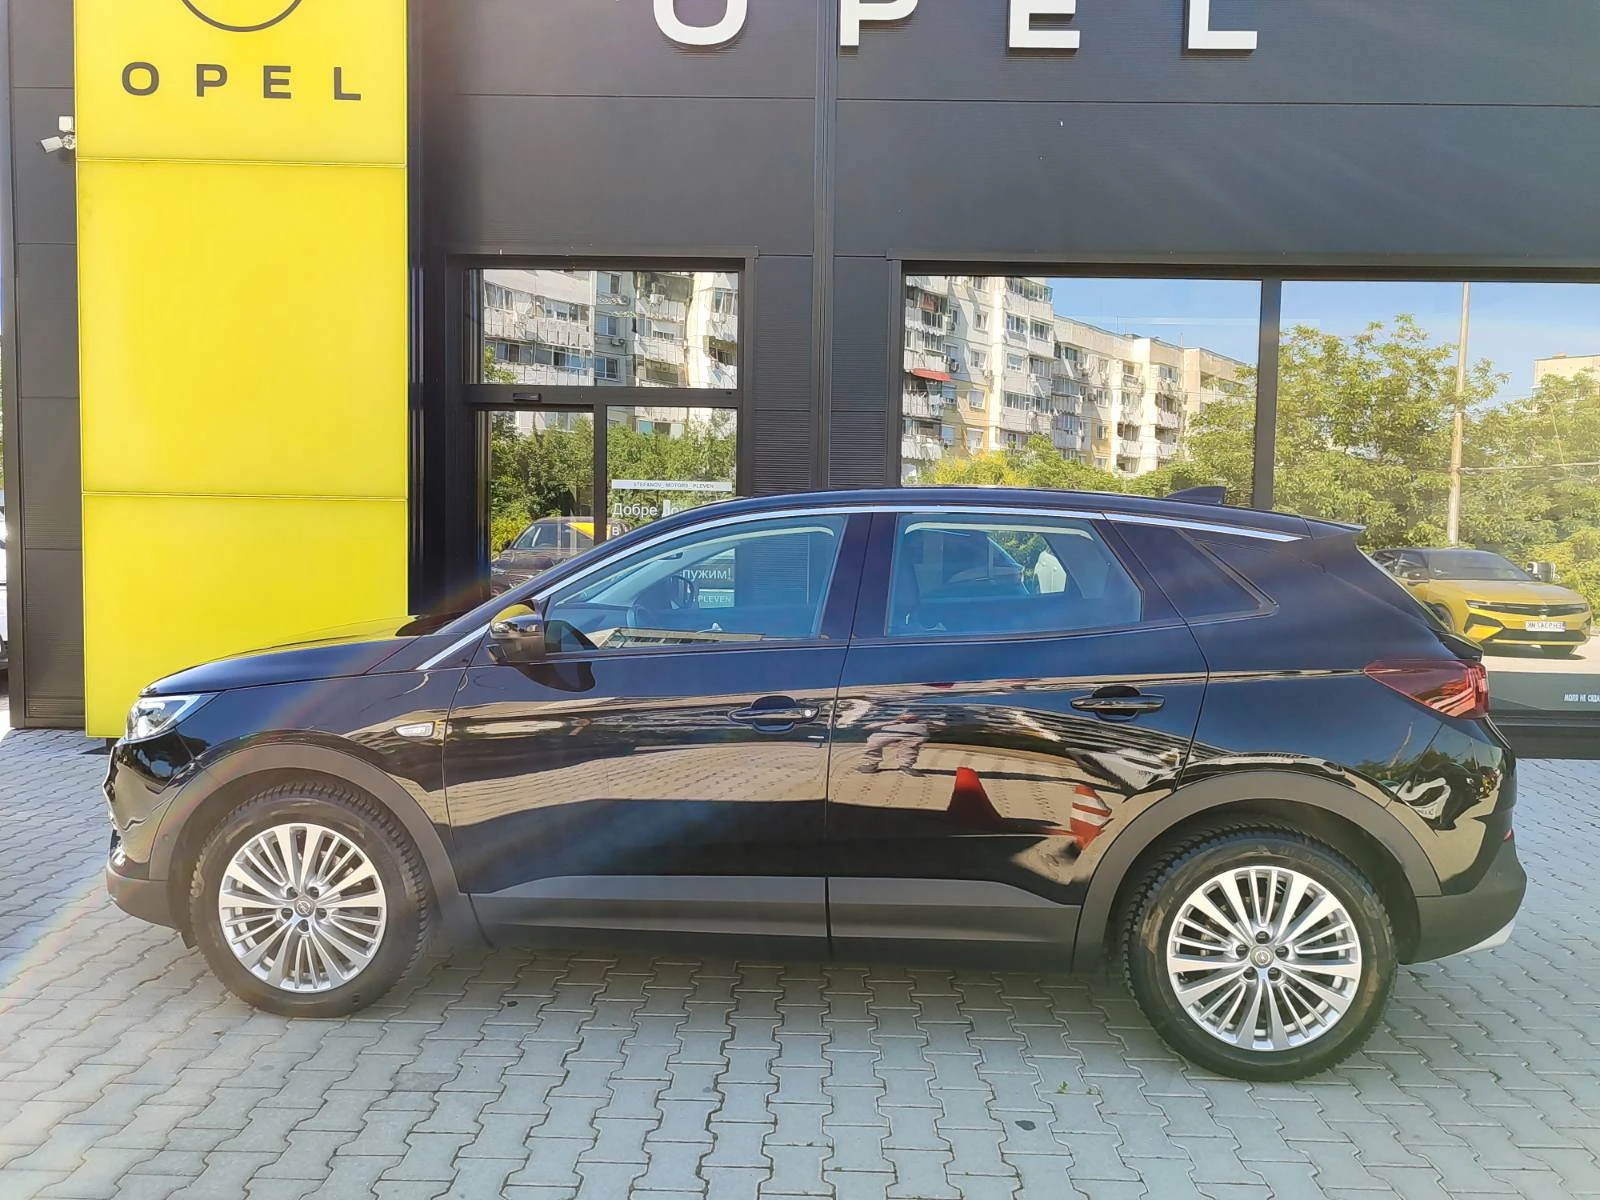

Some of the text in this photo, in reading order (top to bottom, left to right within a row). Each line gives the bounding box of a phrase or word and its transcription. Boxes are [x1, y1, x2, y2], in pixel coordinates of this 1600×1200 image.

[653, 0, 1258, 50] OPEL
[121, 61, 362, 101] OPEL
[613, 503, 658, 518] Добре
